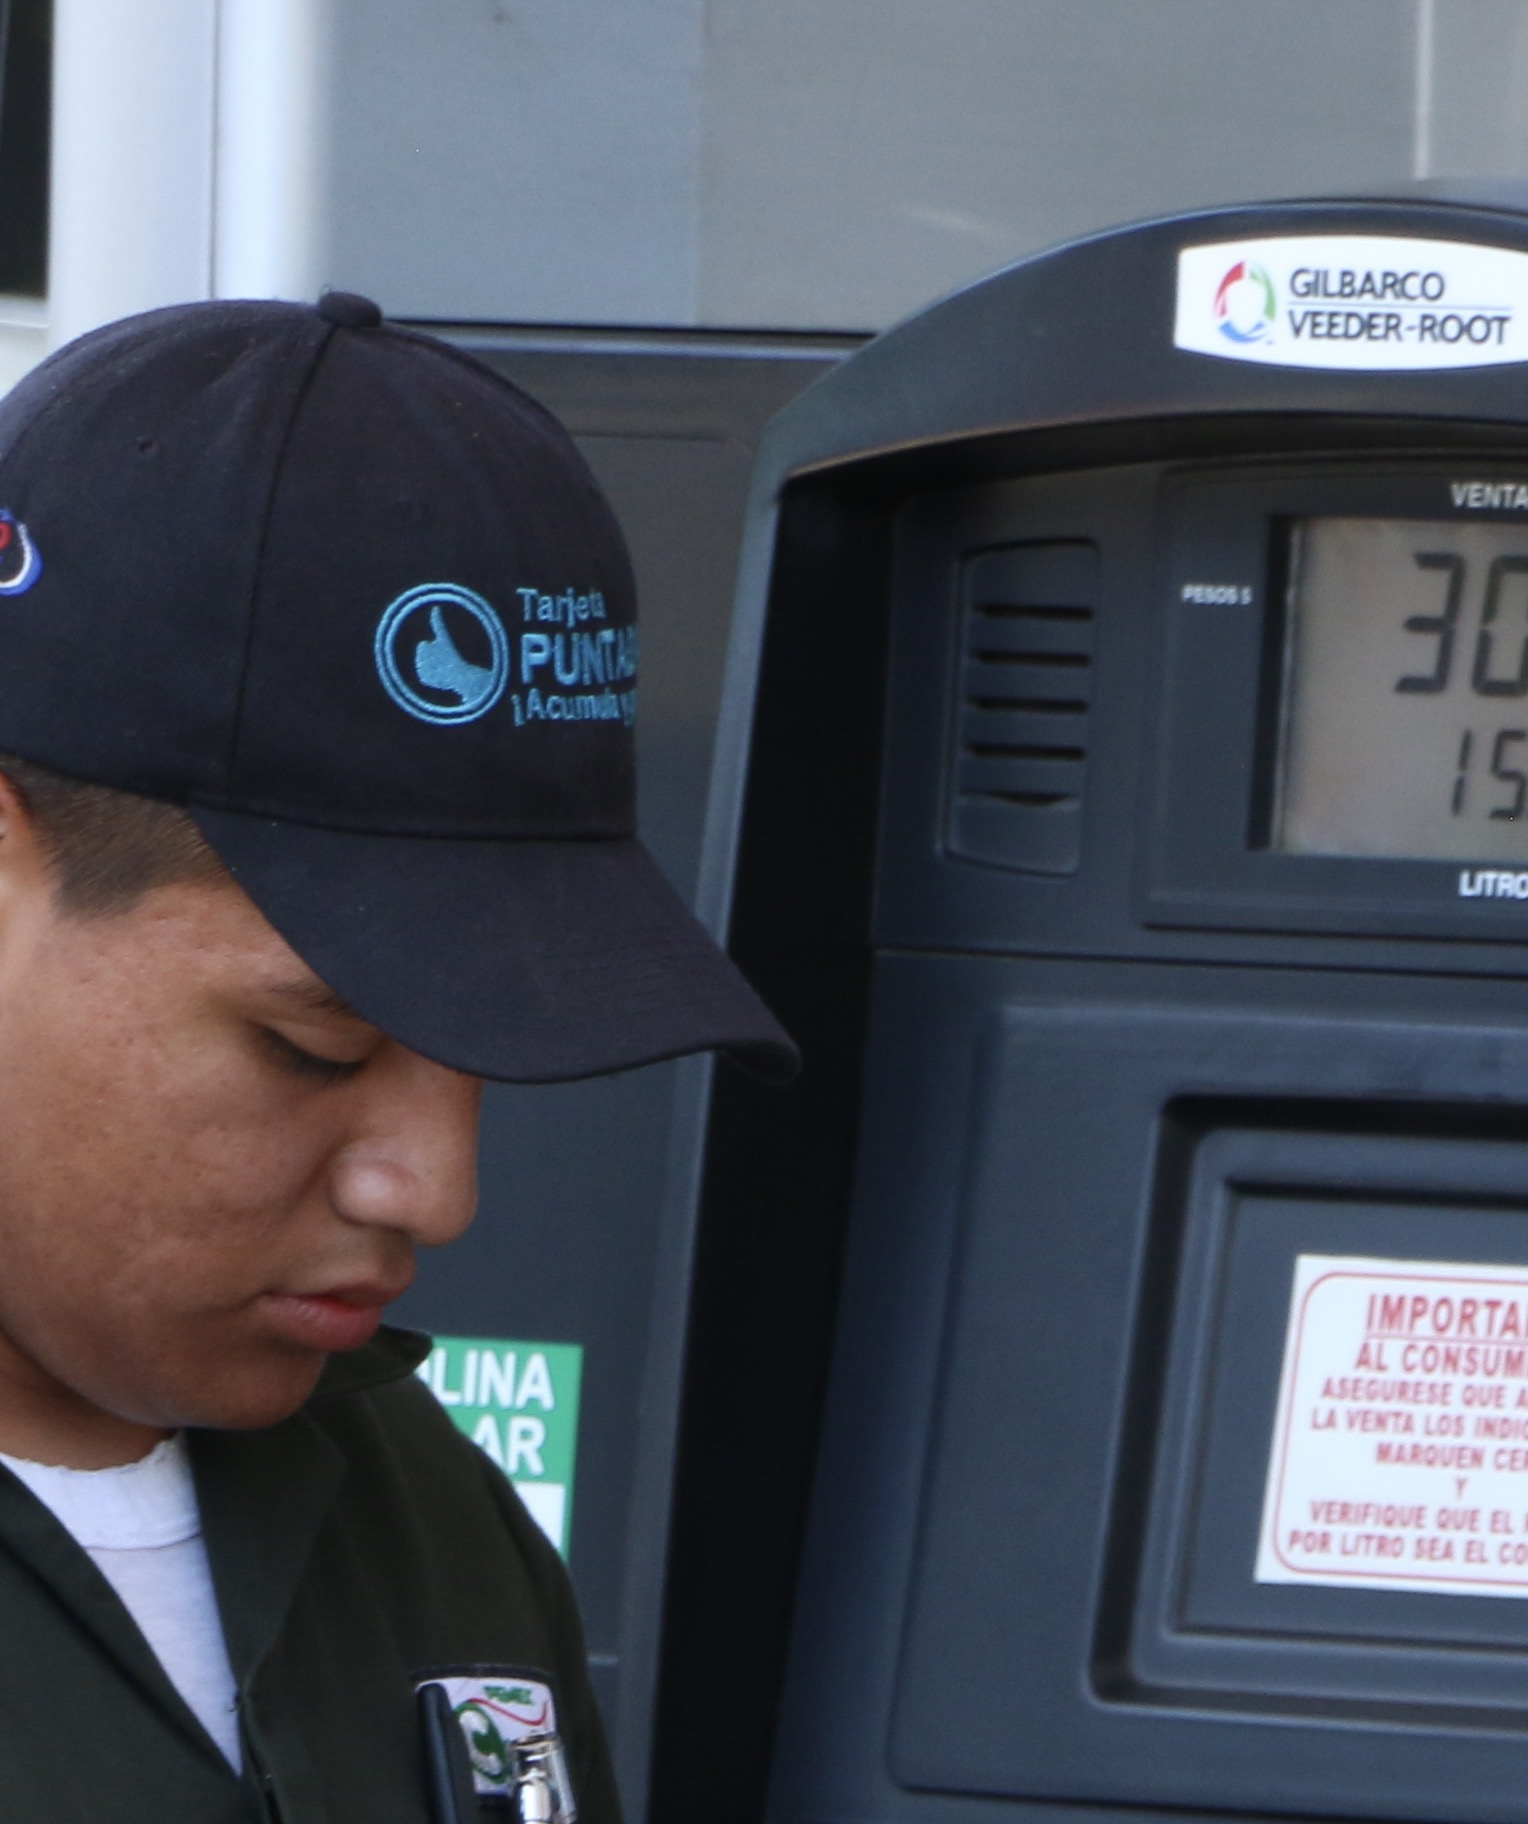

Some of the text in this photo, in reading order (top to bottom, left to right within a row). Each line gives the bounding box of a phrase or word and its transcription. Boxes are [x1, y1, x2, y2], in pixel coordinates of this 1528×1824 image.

[1289, 267, 1445, 301] GILBARCO
[1288, 309, 1512, 345] VEEDER-ROOT
[1181, 584, 1238, 605] PESOS
[1355, 1342, 1389, 1373] AL
[414, 1347, 555, 1411] LINA
[1321, 1377, 1453, 1407] ASEGURESE
[1461, 1384, 1507, 1410] QUE
[1311, 1407, 1338, 1432] LA
[1346, 1410, 1415, 1437] VENTA
[1423, 1414, 1466, 1438] LOS
[1375, 1441, 1484, 1470] MARQUEN
[1453, 1476, 1469, 1500] Y
[1310, 1499, 1427, 1529] VERIFIQUE
[1436, 1507, 1482, 1533] QUE
[1490, 1510, 1515, 1535] EL
[1288, 1529, 1332, 1555] POR
[1340, 1533, 1405, 1560] LITRO
[1414, 1537, 1455, 1562] SEA
[1463, 1539, 1489, 1565] EL
